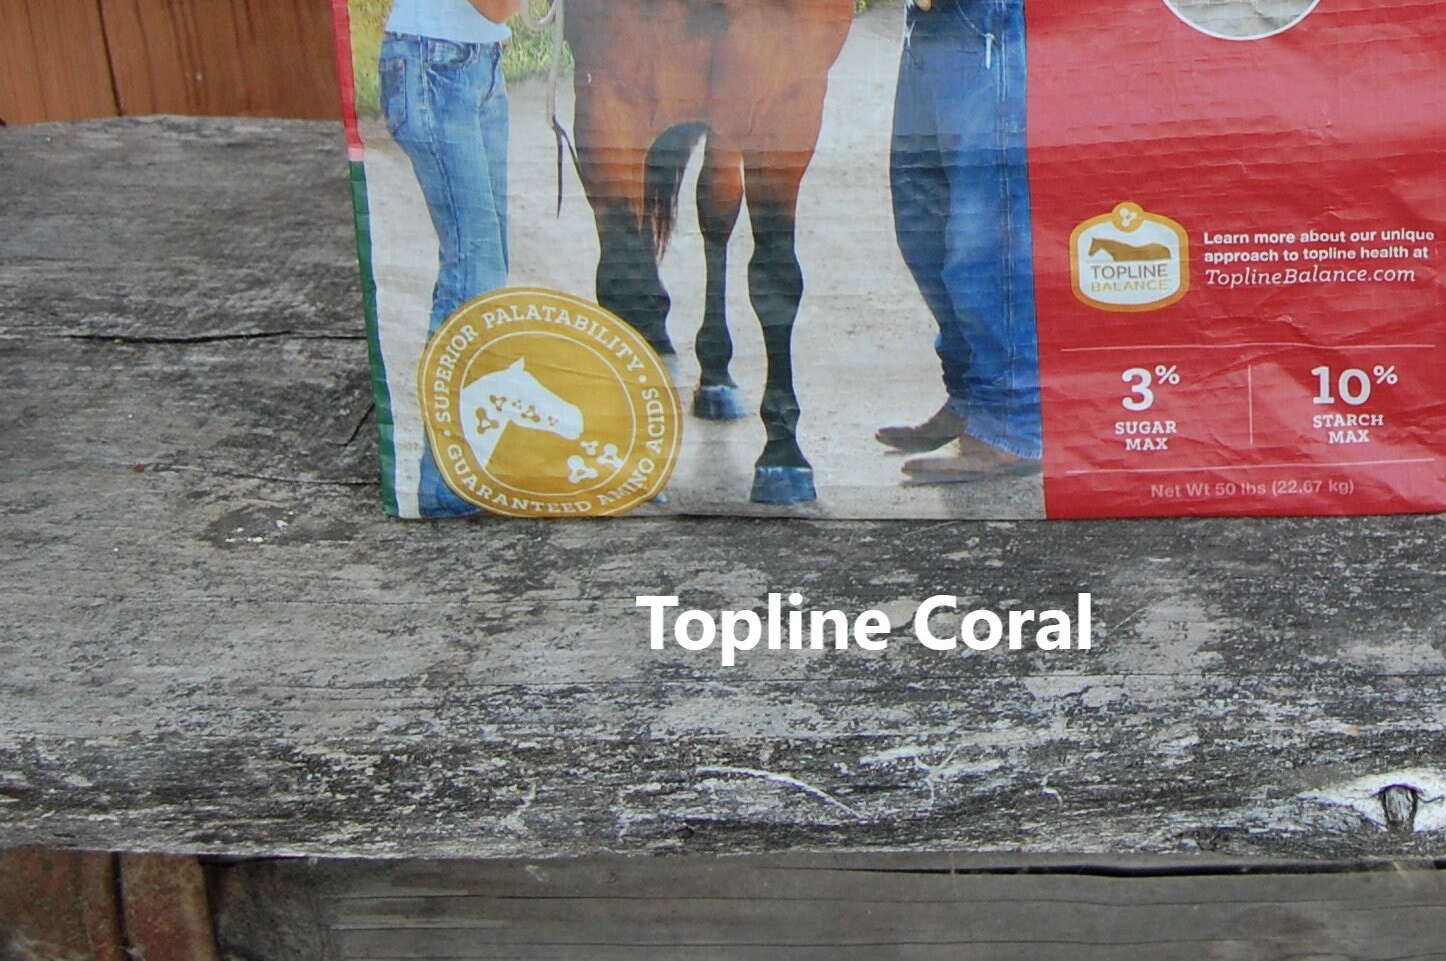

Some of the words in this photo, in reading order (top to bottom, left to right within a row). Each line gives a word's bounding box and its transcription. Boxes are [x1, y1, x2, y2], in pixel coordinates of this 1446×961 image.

[1203, 231, 1250, 246] Learn
[1254, 232, 1296, 245] more
[1300, 229, 1346, 244] about
[1350, 230, 1378, 242] our
[1380, 228, 1435, 244] unique
[1204, 248, 1279, 265] approach
[1282, 249, 1299, 261] to
[1303, 247, 1356, 262] topline
[1360, 245, 1409, 260] health
[1413, 246, 1429, 259] at
[1090, 264, 1169, 280] TOPLINE
[1206, 265, 1416, 288] ToplineBalance.com
[434, 324, 479, 422] SUPERIOR
[481, 303, 645, 372] PALATABILITY
[1115, 420, 1177, 435] SUGAR
[1312, 414, 1384, 429] STARCH
[1125, 437, 1169, 451] MAX
[1328, 430, 1371, 444] MAX
[446, 444, 592, 513] GUARANTEED
[597, 457, 655, 507] AMINO
[641, 387, 665, 455] ACIDS
[1151, 483, 1182, 498] Net
[1185, 483, 1212, 497] Wt
[1215, 483, 1236, 496] 50
[1240, 481, 1266, 495] lbs
[1272, 479, 1324, 497] (22.67
[1328, 478, 1354, 496] kg)
